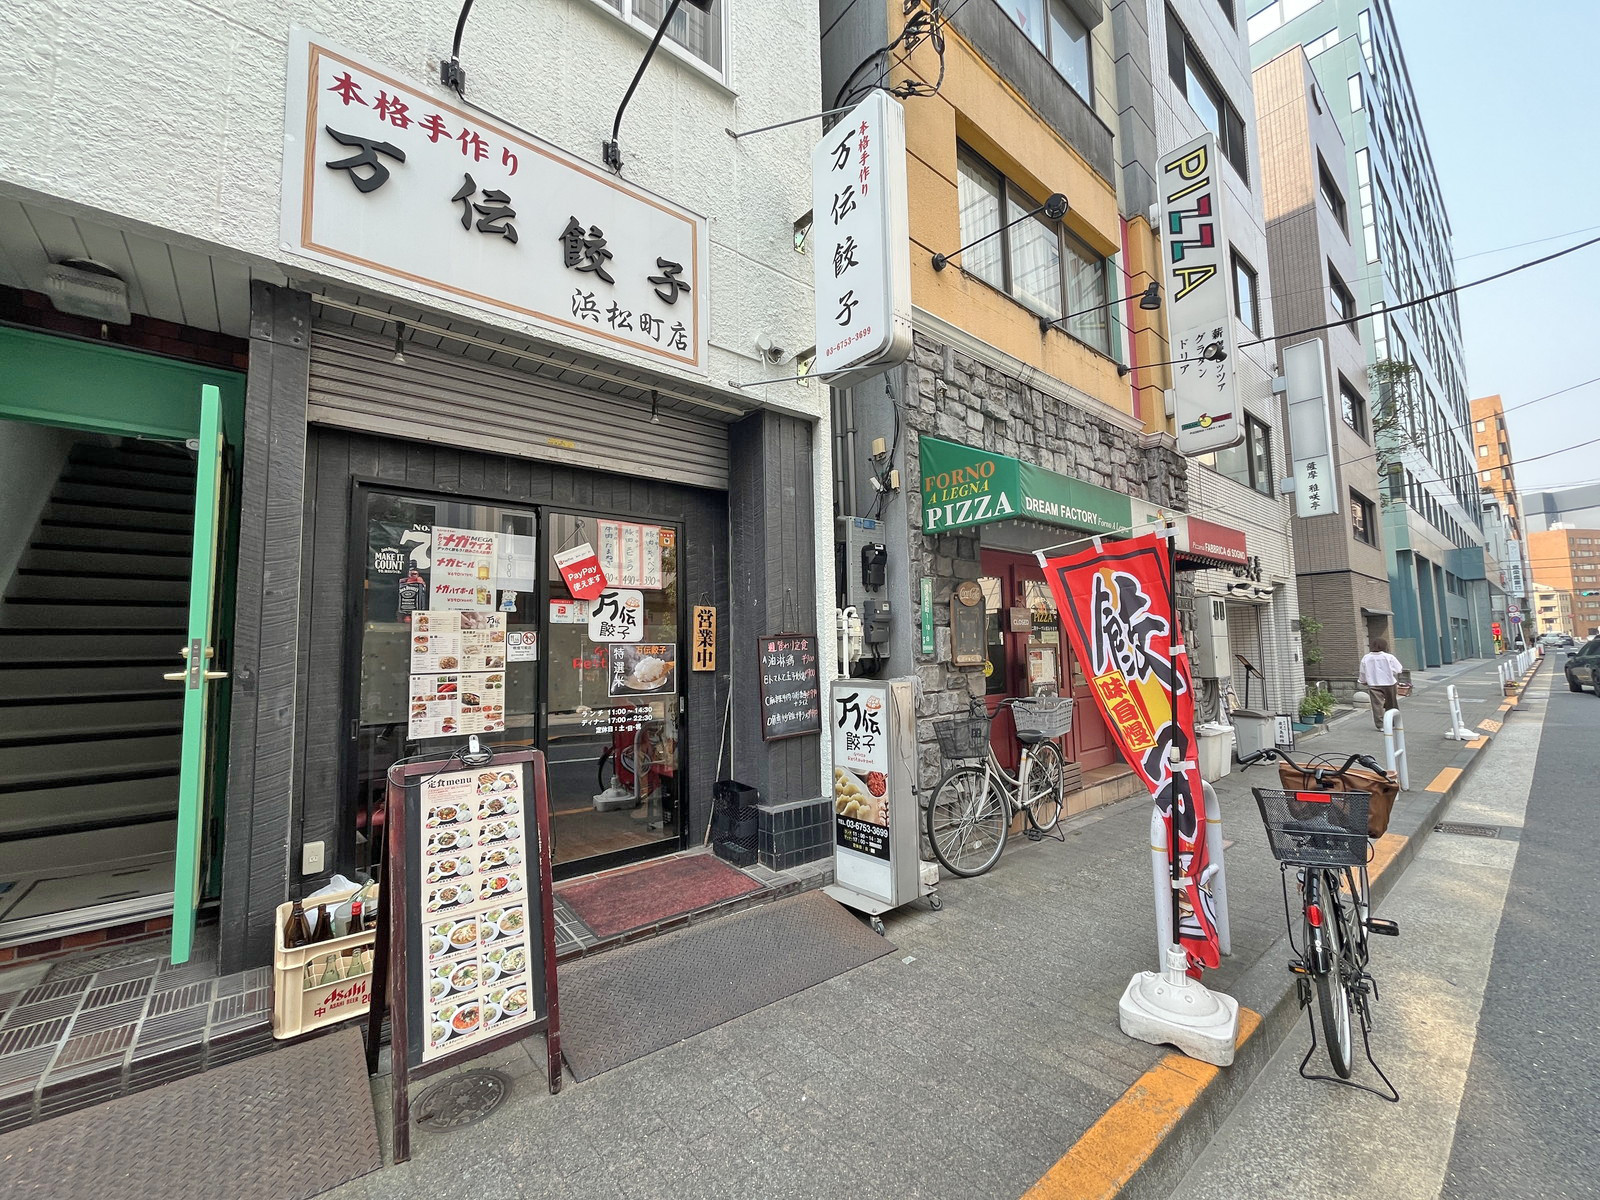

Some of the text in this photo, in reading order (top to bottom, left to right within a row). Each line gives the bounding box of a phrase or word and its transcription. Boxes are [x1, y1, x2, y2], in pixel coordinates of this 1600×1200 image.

[327, 71, 520, 176] 本格手作り
[858, 120, 870, 197] 本格手作り
[325, 124, 691, 305] 万伝餃子
[830, 129, 859, 327] 万伝餃子
[1165, 144, 1217, 303] PIZZA
[571, 289, 688, 353] 浜松町店
[826, 326, 872, 357] 03-6753-3699
[1180, 339, 1190, 375] ドリア
[925, 461, 996, 492] FORNO
[928, 480, 990, 504] A LEGNA
[926, 491, 1015, 530] PIZZA
[1026, 496, 1059, 517] DREAM
[1060, 507, 1098, 525] FACTORY
[1098, 518, 1112, 529] Forno
[413, 524, 430, 532] No.
[400, 530, 431, 570] 7
[469, 542, 493, 550] サイズ
[1204, 542, 1226, 556] FABBRICA
[1231, 548, 1246, 560] SOGNO
[375, 560, 404, 570] COUNT
[436, 558, 474, 568] メガビール
[568, 565, 597, 581] PayPay
[436, 584, 474, 595] メガハイボール
[573, 574, 601, 592] 使えます
[592, 592, 636, 627] 万伝
[1034, 612, 1053, 622] PIZZA
[600, 621, 630, 639] 餃子
[697, 609, 714, 668] 営業中
[636, 645, 666, 654] 万伝餃子
[614, 647, 624, 688] 特選米
[836, 692, 881, 735] 万伝
[1099, 677, 1152, 748] 味自慢
[846, 731, 876, 753] 餃子
[846, 819, 888, 838] 03-6753-3699
[324, 980, 366, 1005] Asahi
[330, 1000, 345, 1010] ASAHI
[346, 997, 359, 1006] BEER
[314, 1007, 326, 1017] 中
